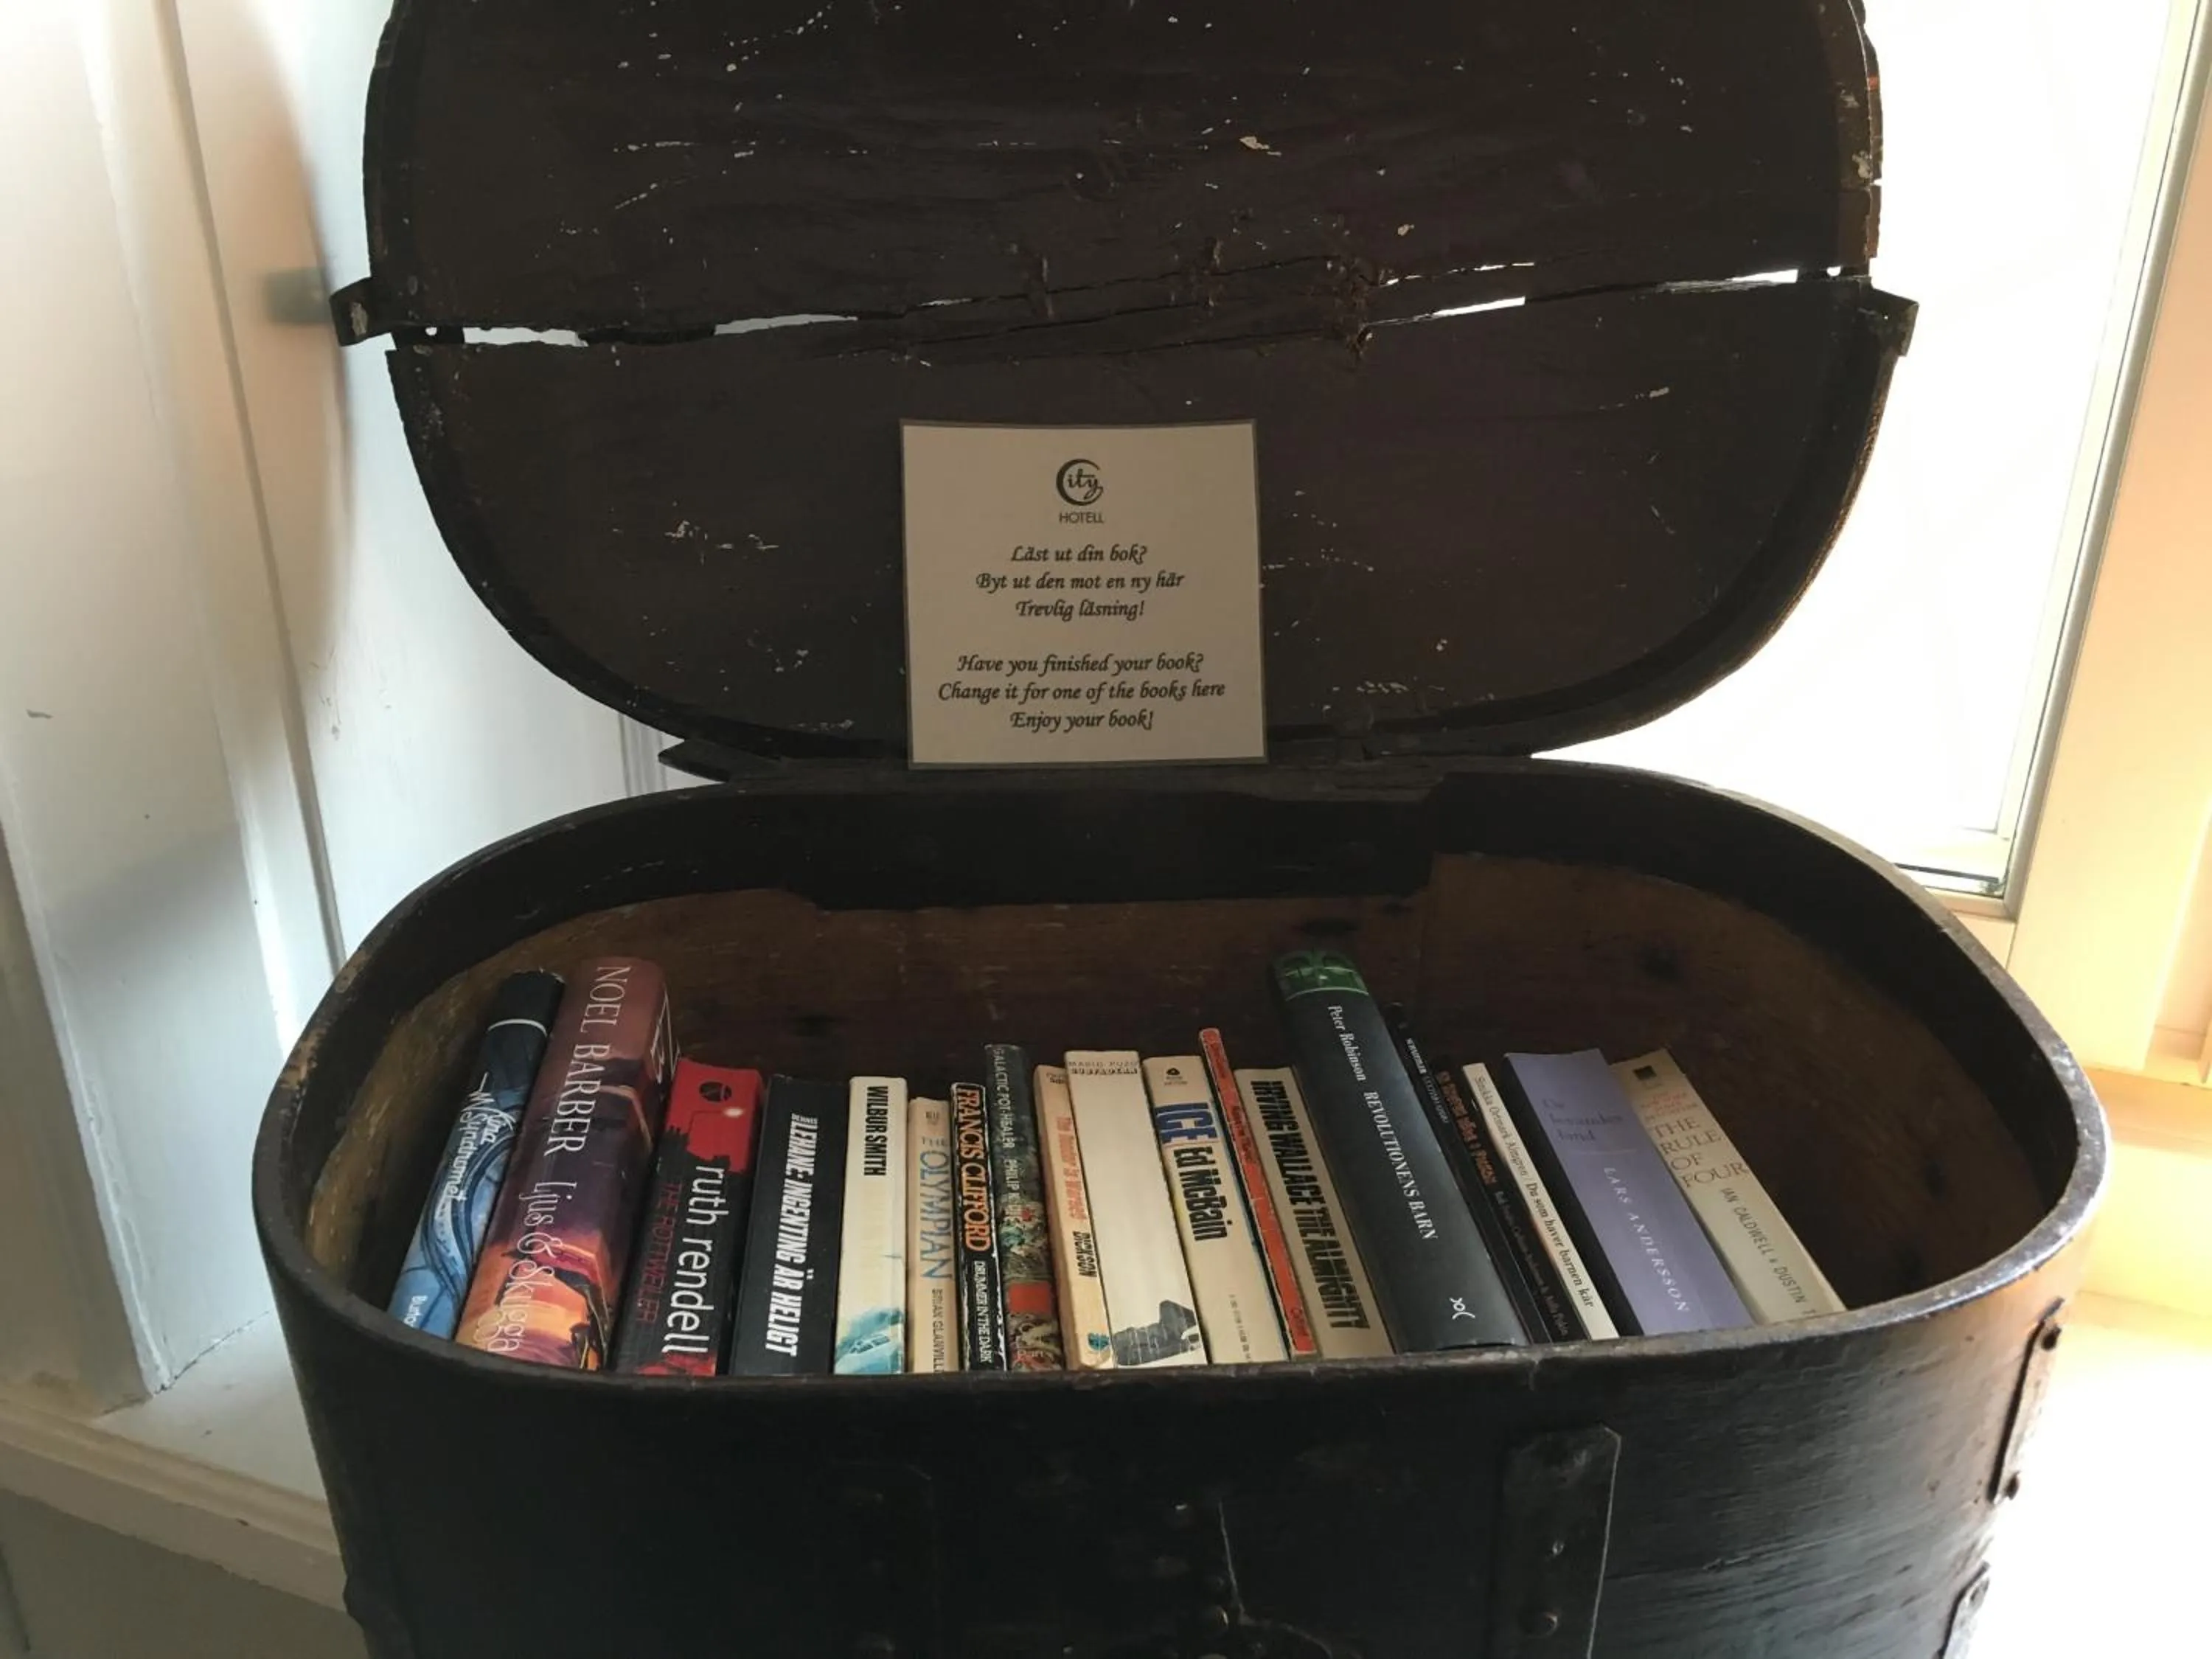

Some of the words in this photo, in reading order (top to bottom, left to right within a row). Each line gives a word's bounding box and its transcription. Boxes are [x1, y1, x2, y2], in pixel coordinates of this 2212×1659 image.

[1056, 459, 1103, 506] City
[1059, 512, 1104, 524] HOTELL
[1011, 546, 1048, 562] Läst
[1055, 549, 1072, 562] ut
[1078, 545, 1104, 561] din
[1110, 543, 1147, 564] bok?
[976, 573, 1007, 594] Byt
[1013, 576, 1030, 589] ut
[1036, 572, 1065, 589] den
[1070, 575, 1100, 589] mot
[1107, 577, 1126, 589] en
[1131, 577, 1151, 594] ny
[1156, 571, 1184, 588] här
[1015, 600, 1074, 621] Trevlig
[1079, 599, 1144, 621] läsning!
[957, 655, 1003, 672] Have
[1006, 658, 1039, 677] you
[1043, 655, 1109, 677] finished
[1114, 658, 1152, 676] your
[1156, 653, 1204, 674] book?
[939, 683, 1000, 704] Change
[1006, 683, 1018, 700] it
[1018, 683, 1049, 705] for
[1053, 686, 1081, 700] one
[1086, 682, 1107, 704] of
[1110, 683, 1134, 699] the
[1140, 682, 1187, 700] books
[1192, 681, 1225, 696] here
[1010, 711, 1061, 733] Enjoy
[1065, 714, 1105, 732] your
[1109, 709, 1153, 730] book!
[579, 966, 632, 1035] NOEL
[1328, 1004, 1346, 1032] Peter
[1340, 1032, 1366, 1082] Robinson
[993, 1048, 1009, 1092] GALACTIC
[543, 1043, 611, 1157] BARBER
[866, 1085, 888, 1131] WILBUR
[1251, 1080, 1298, 1132] IRVING
[959, 1088, 984, 1160] FRANCIS
[1154, 1103, 1217, 1144] ICE
[1651, 1117, 1702, 1137] THE
[1659, 1130, 1722, 1155] RULE
[863, 1131, 888, 1176] SMITH
[1173, 1146, 1216, 1168] Ed
[1269, 1132, 1325, 1206] WALLACE
[1363, 1091, 1419, 1199] REVOLUTIONENS
[1408, 1200, 1439, 1240] BARN
[1671, 1152, 1702, 1171] OF
[1681, 1161, 1749, 1188] FOUR
[519, 1181, 577, 1226] Ljus
[686, 1166, 729, 1225] ruth
[920, 1150, 953, 1281] OLYMPIAN
[961, 1162, 991, 1251] CLIFFORD
[1180, 1169, 1233, 1242] McBain
[776, 1176, 812, 1265] INGENTING
[1293, 1208, 1337, 1238] THE
[1603, 1166, 1632, 1204] LARS
[1627, 1211, 1690, 1312] ANDERSSON
[517, 1232, 563, 1258] &
[1073, 1231, 1097, 1277] DICKSON
[1534, 1197, 1548, 1220] som
[1542, 1218, 1564, 1248] haver
[1559, 1246, 1584, 1286] barnen
[1578, 1286, 1594, 1308] kär
[1720, 1188, 1739, 1202] IAN
[1734, 1207, 1775, 1256] CALDWELL
[1774, 1266, 1807, 1303] DUSTIN
[636, 1216, 676, 1324] ROTTWEILER
[772, 1262, 813, 1293] ÄR
[1304, 1238, 1370, 1329] ALMIGHTY
[403, 1294, 428, 1326] Burto
[474, 1260, 554, 1352] Skugga
[661, 1237, 714, 1353] rendell
[765, 1289, 801, 1357] HELIGT
